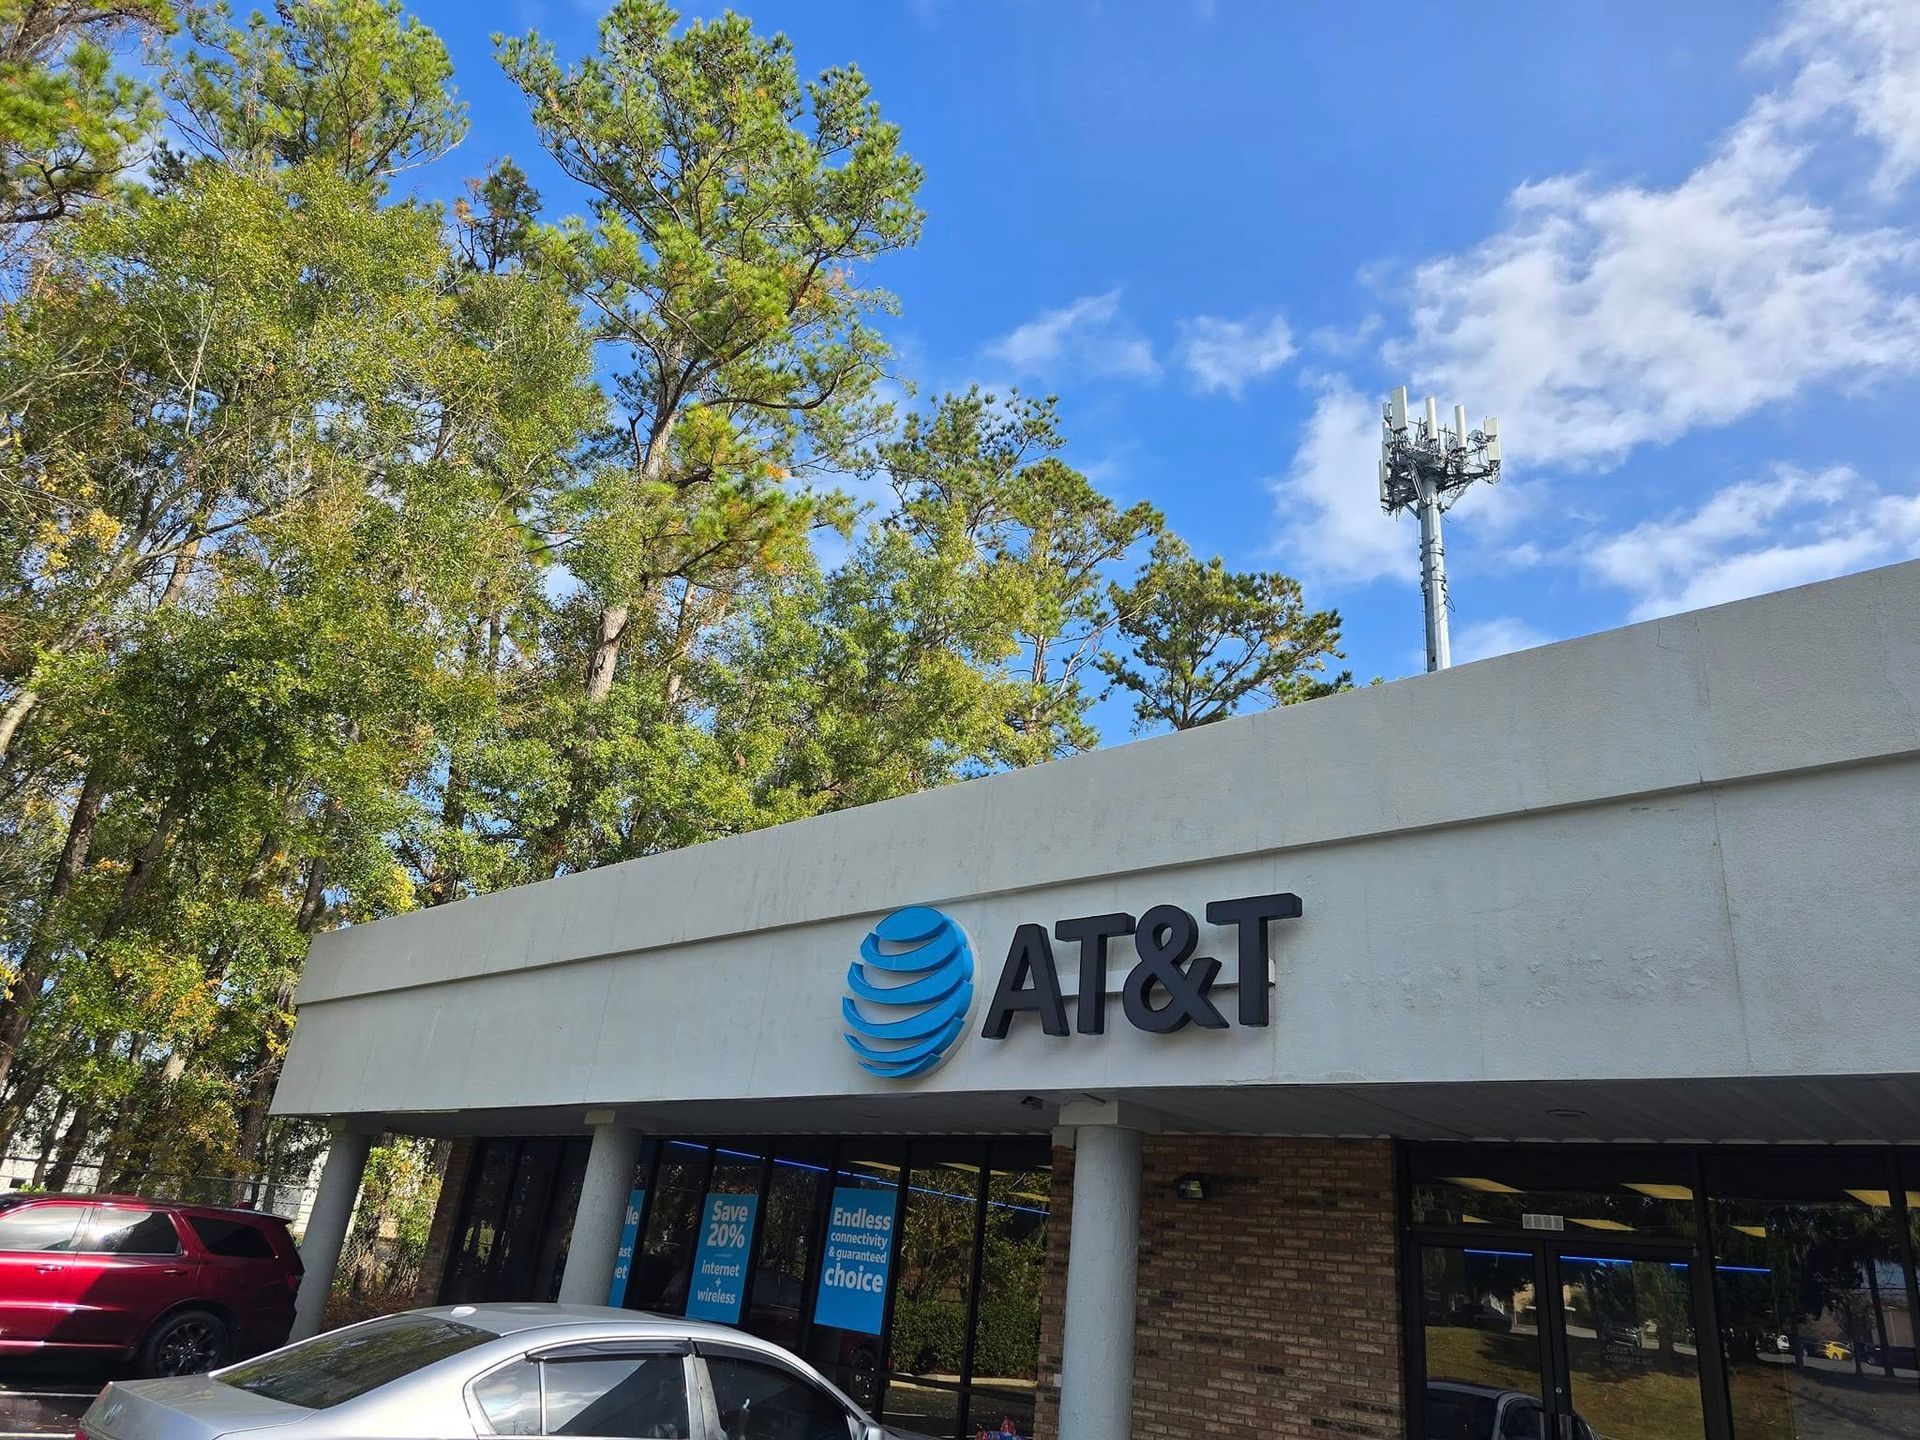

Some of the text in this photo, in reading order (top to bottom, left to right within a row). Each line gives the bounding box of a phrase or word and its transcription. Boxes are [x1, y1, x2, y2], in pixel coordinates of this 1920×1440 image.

[981, 893, 1302, 1039] AT&T
[711, 1200, 748, 1223] Save
[833, 1207, 892, 1231] Endless
[706, 1223, 745, 1249] 20%
[830, 1232, 888, 1250] connectivity
[618, 1246, 632, 1258] ast
[828, 1246, 887, 1264] & guaranteed
[701, 1259, 740, 1277] internet
[824, 1262, 883, 1293] choice
[697, 1288, 736, 1305] wireless
